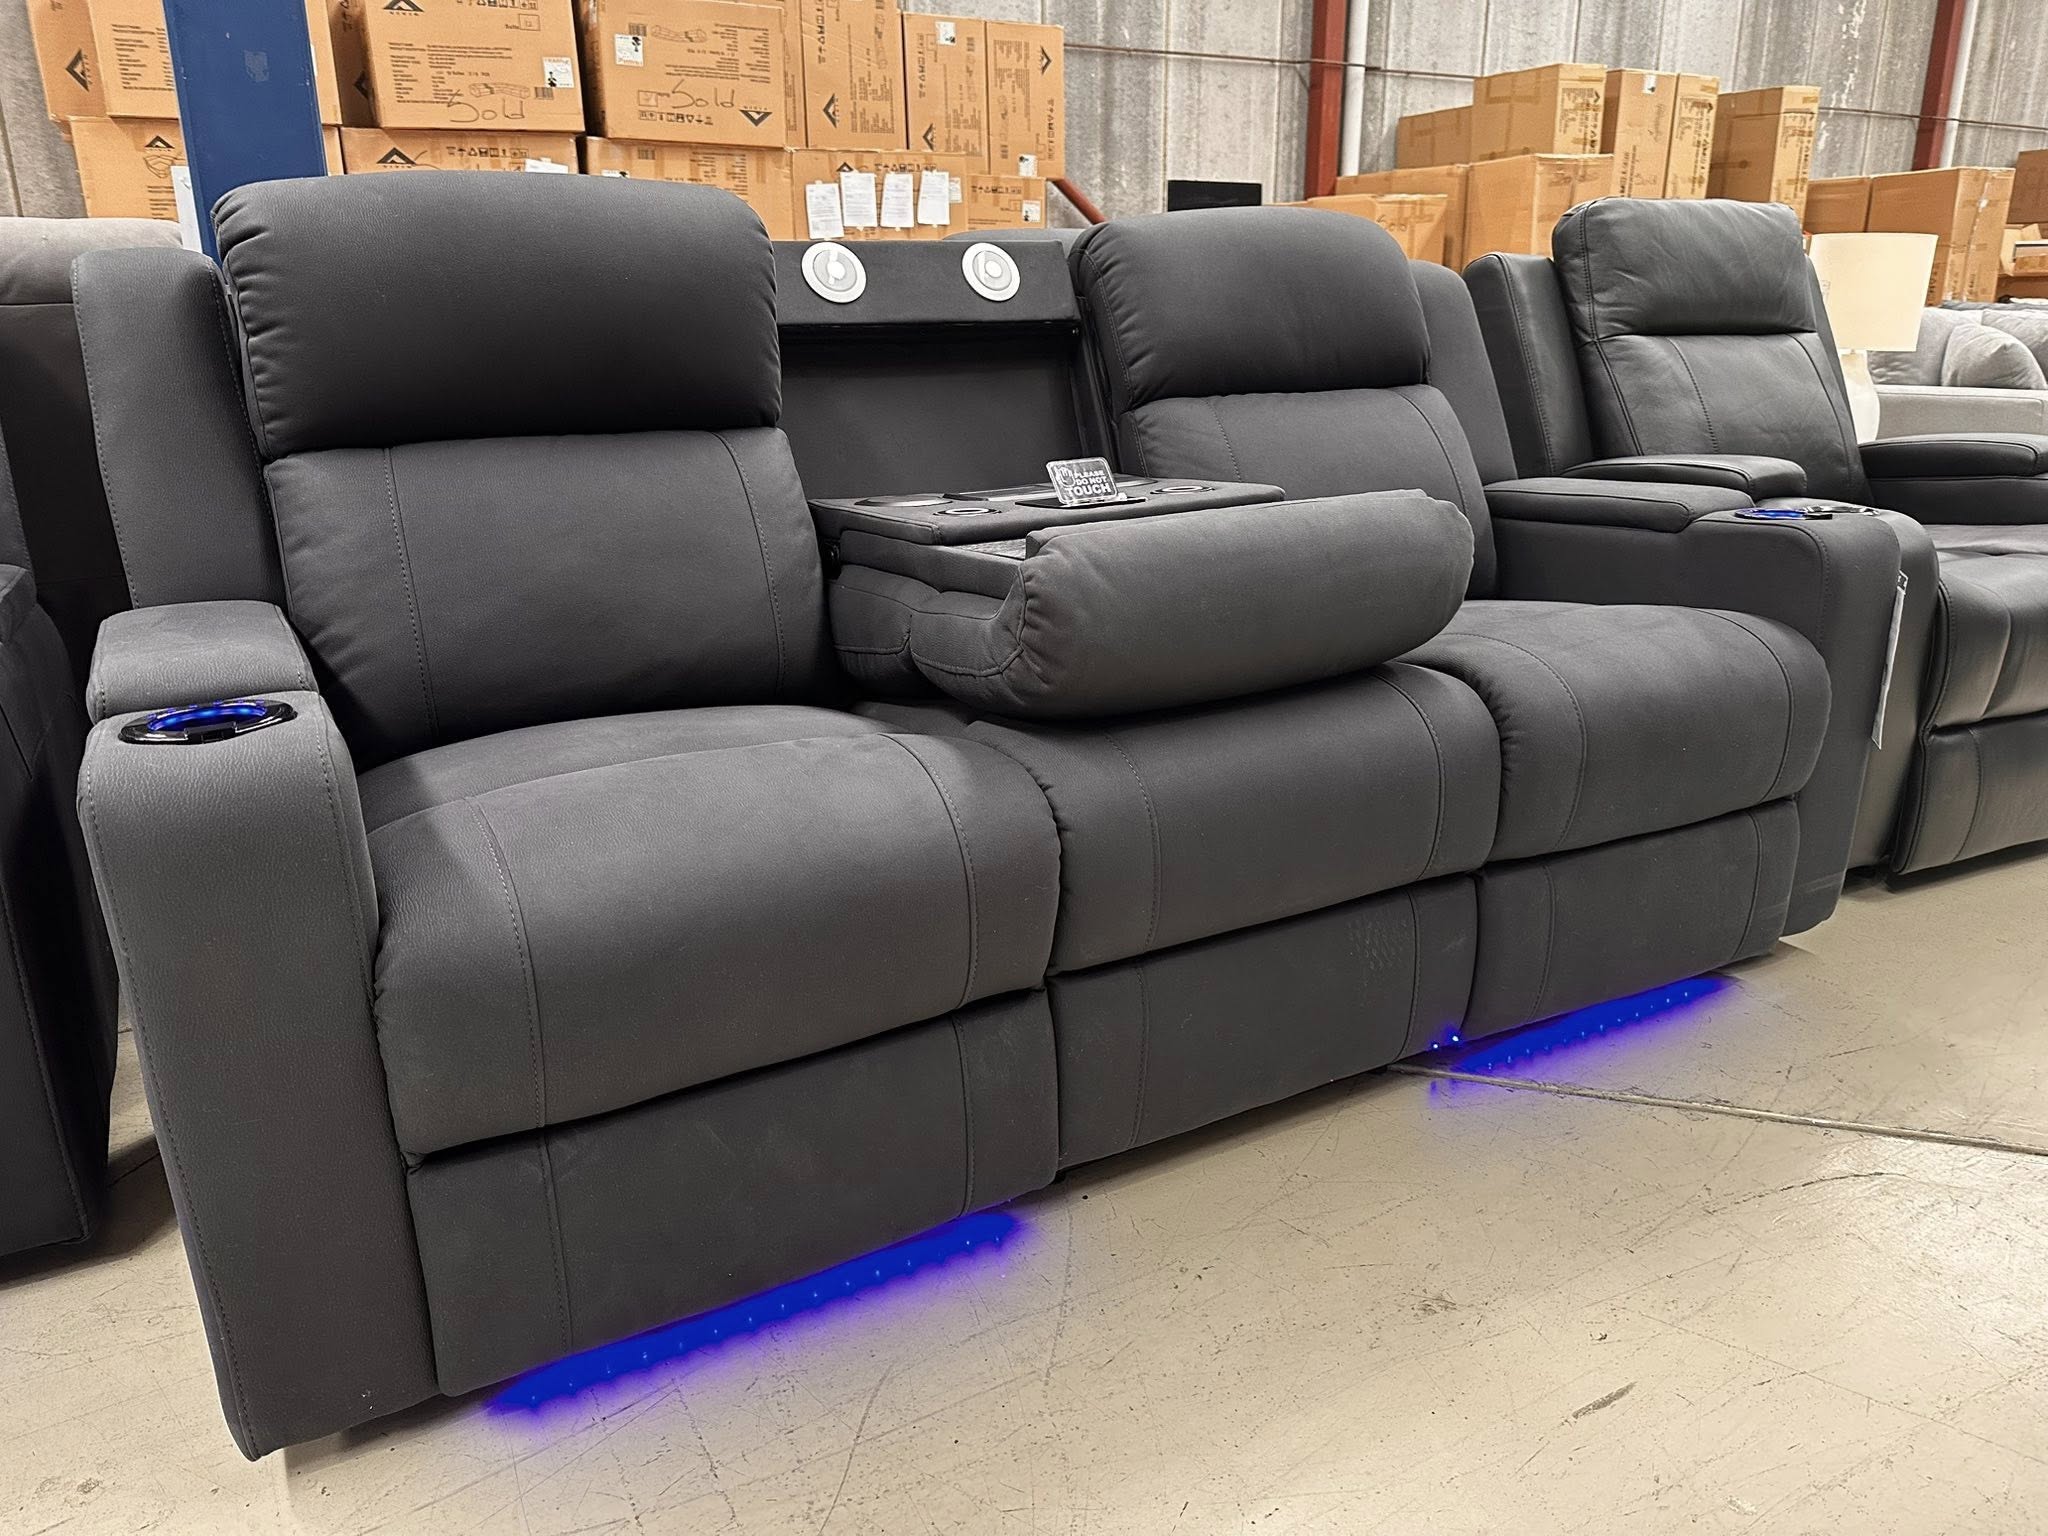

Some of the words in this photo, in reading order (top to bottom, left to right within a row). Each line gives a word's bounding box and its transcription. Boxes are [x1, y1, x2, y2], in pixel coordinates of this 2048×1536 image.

[672, 79, 735, 109] Sold
[447, 89, 525, 123] Sold
[1074, 470, 1105, 479] PLEASE
[1076, 478, 1089, 486] DO
[1089, 476, 1107, 484] NOT
[1064, 483, 1111, 496] TOUCH
